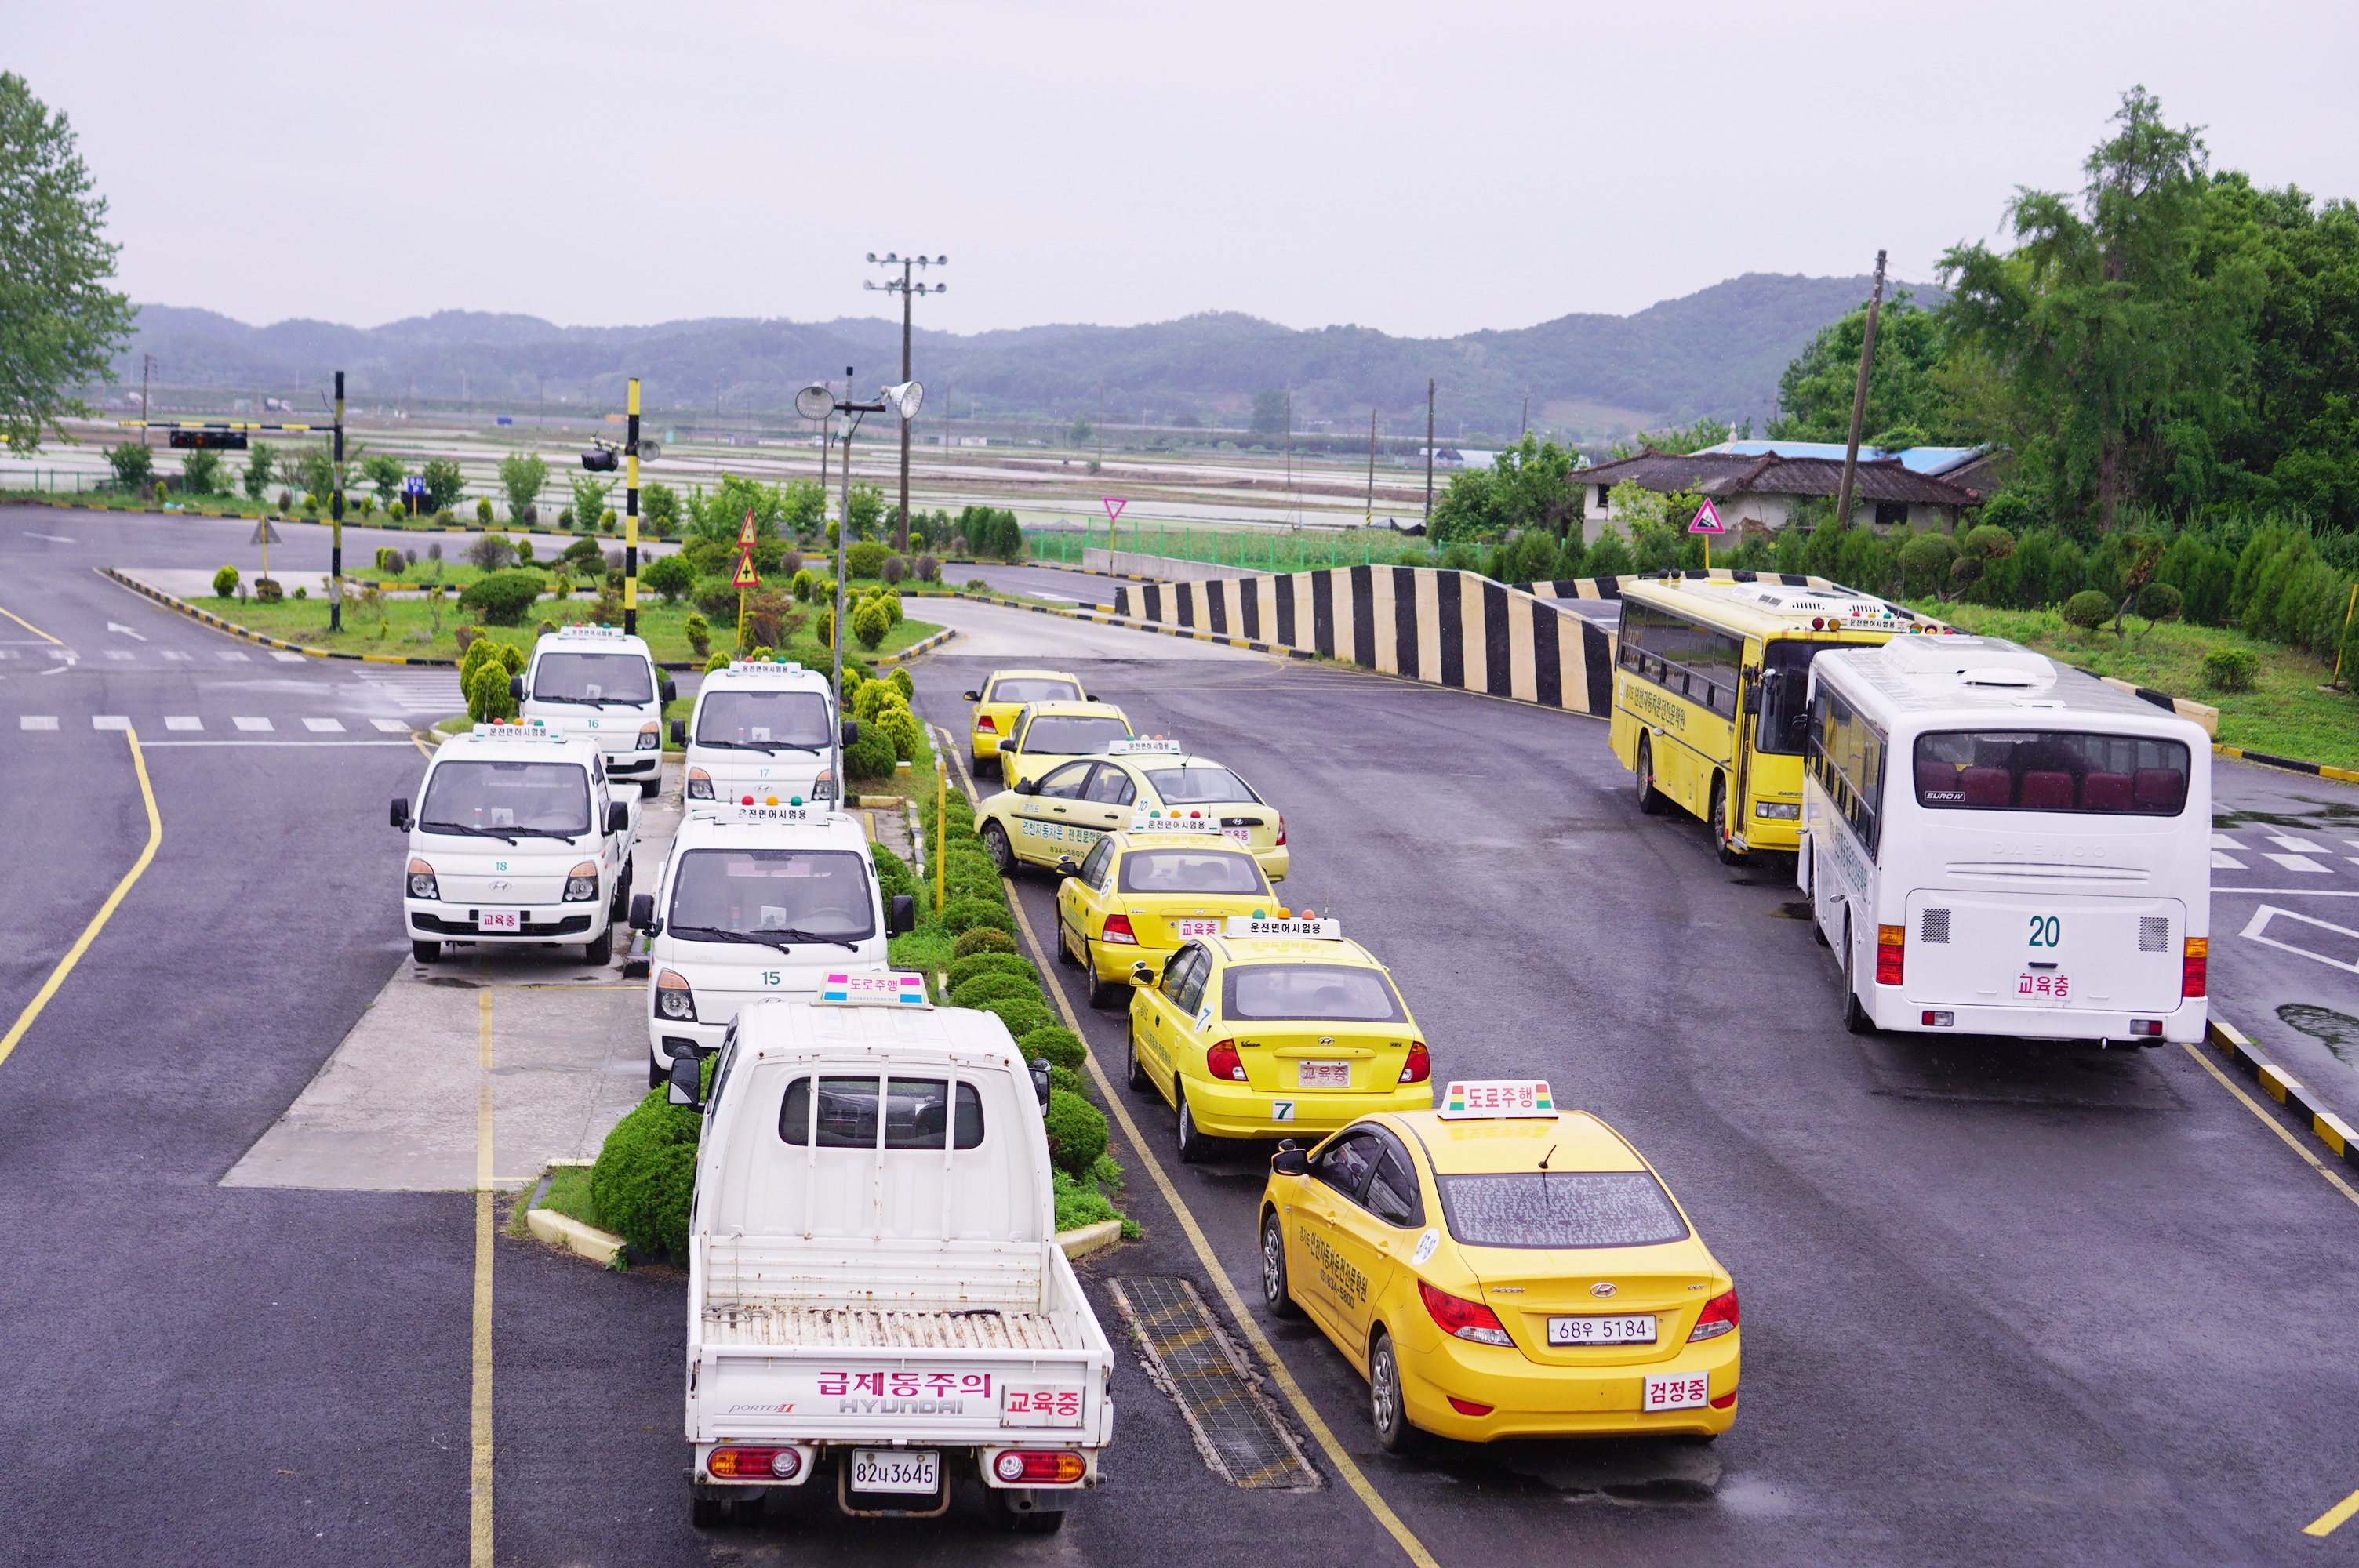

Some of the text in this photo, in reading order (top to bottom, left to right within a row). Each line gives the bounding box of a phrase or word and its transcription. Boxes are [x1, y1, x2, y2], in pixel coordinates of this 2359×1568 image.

[1849, 619, 1895, 628] 운전면허시험용
[572, 629, 613, 637] 운전면허시험용
[742, 665, 788, 673] 운전면허시험용
[587, 719, 599, 728] 16
[489, 727, 547, 737] 운전면허시험용
[758, 768, 770, 778] 17
[1023, 803, 1040, 813] 경기도
[1138, 800, 1148, 811] 10
[1148, 820, 1205, 829] 운전면허시험용
[1049, 846, 1085, 858] 834-5800
[1993, 841, 2106, 858] DAEWOO
[496, 862, 507, 871] 18
[1101, 878, 1113, 896] 6
[484, 914, 515, 927] 교육중
[1250, 922, 1321, 935] 운전면허시험용
[2029, 915, 2060, 948] 20
[761, 971, 781, 985] 15
[850, 978, 898, 992] 도로주행
[1196, 1007, 1212, 1030] 7
[1303, 1066, 1347, 1081] 교육중
[1469, 1087, 1532, 1109] 도로주행
[1274, 1102, 1292, 1120] 7
[1559, 1319, 1647, 1339] 68우 5184
[817, 1371, 991, 1399] 급제동주의
[1649, 1378, 1706, 1405] 검정중
[839, 1398, 964, 1415] HYUNDAI
[1006, 1391, 1080, 1417] 교육중
